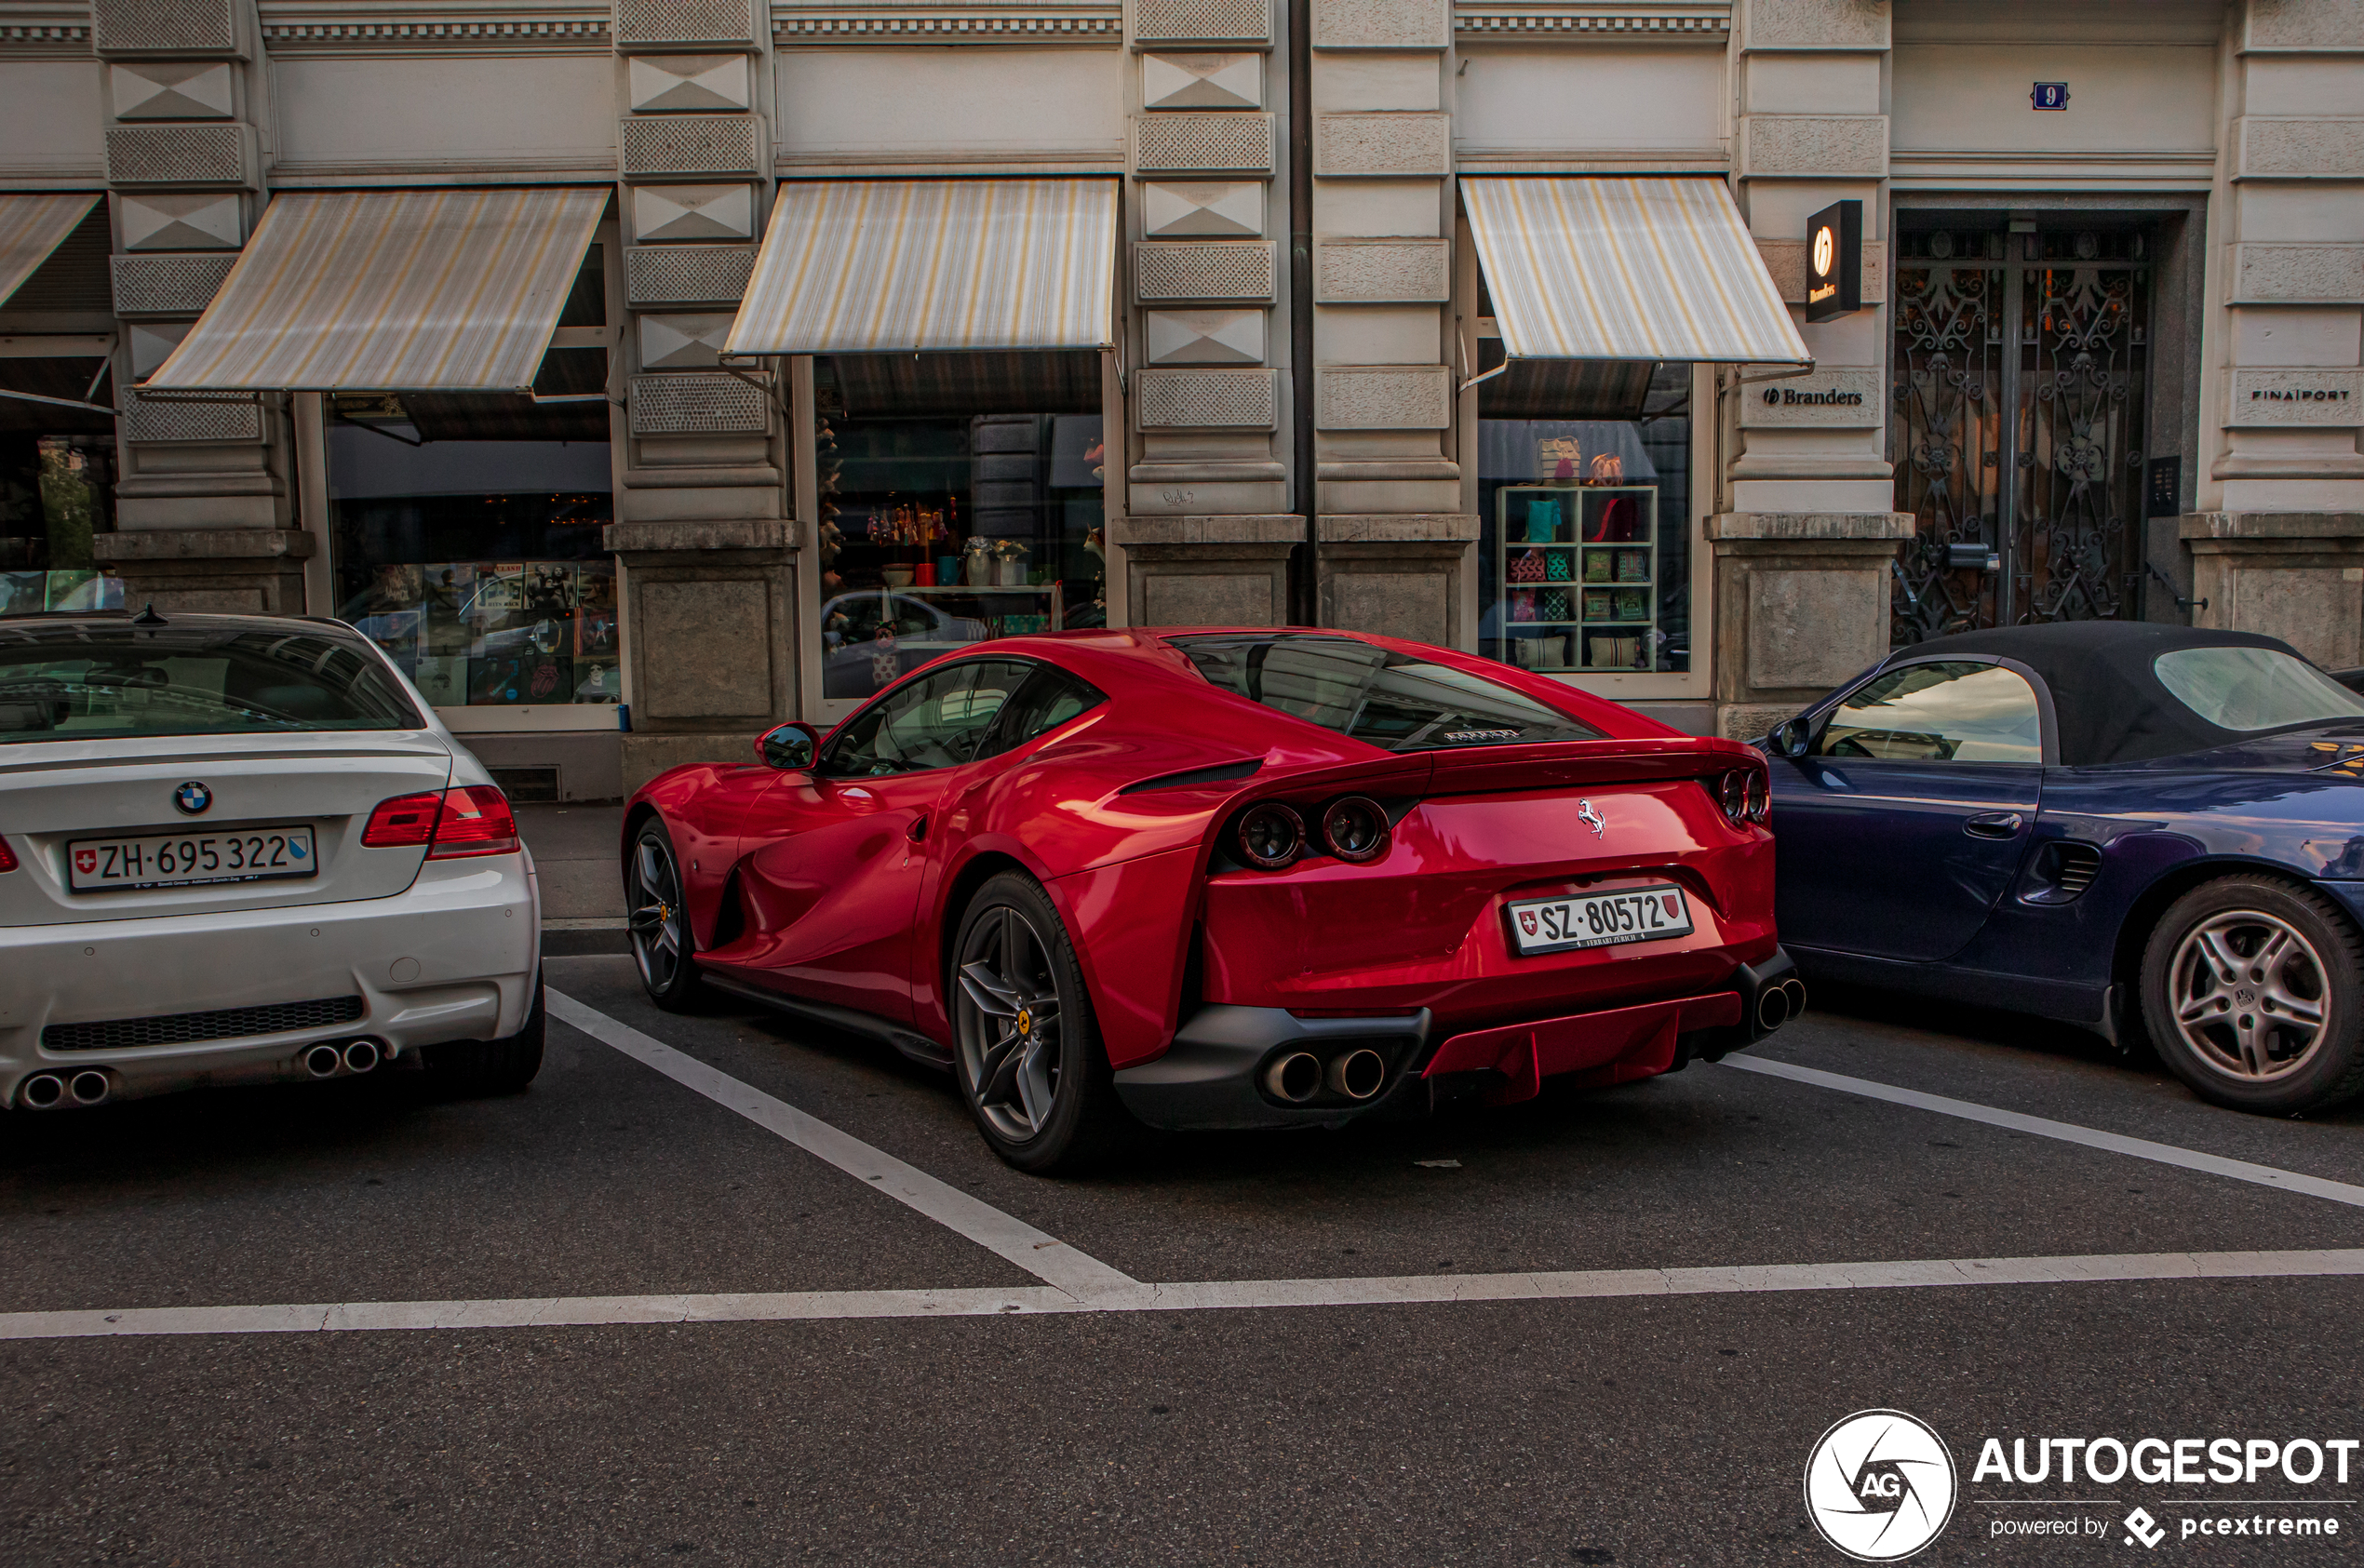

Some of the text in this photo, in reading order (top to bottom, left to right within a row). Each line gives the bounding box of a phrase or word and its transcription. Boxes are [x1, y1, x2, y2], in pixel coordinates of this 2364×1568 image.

[2046, 87, 2056, 105] 9
[1783, 388, 1862, 405] Branders
[177, 782, 209, 794] BMW
[1586, 934, 1636, 946] FERRARI ZÜRICH
